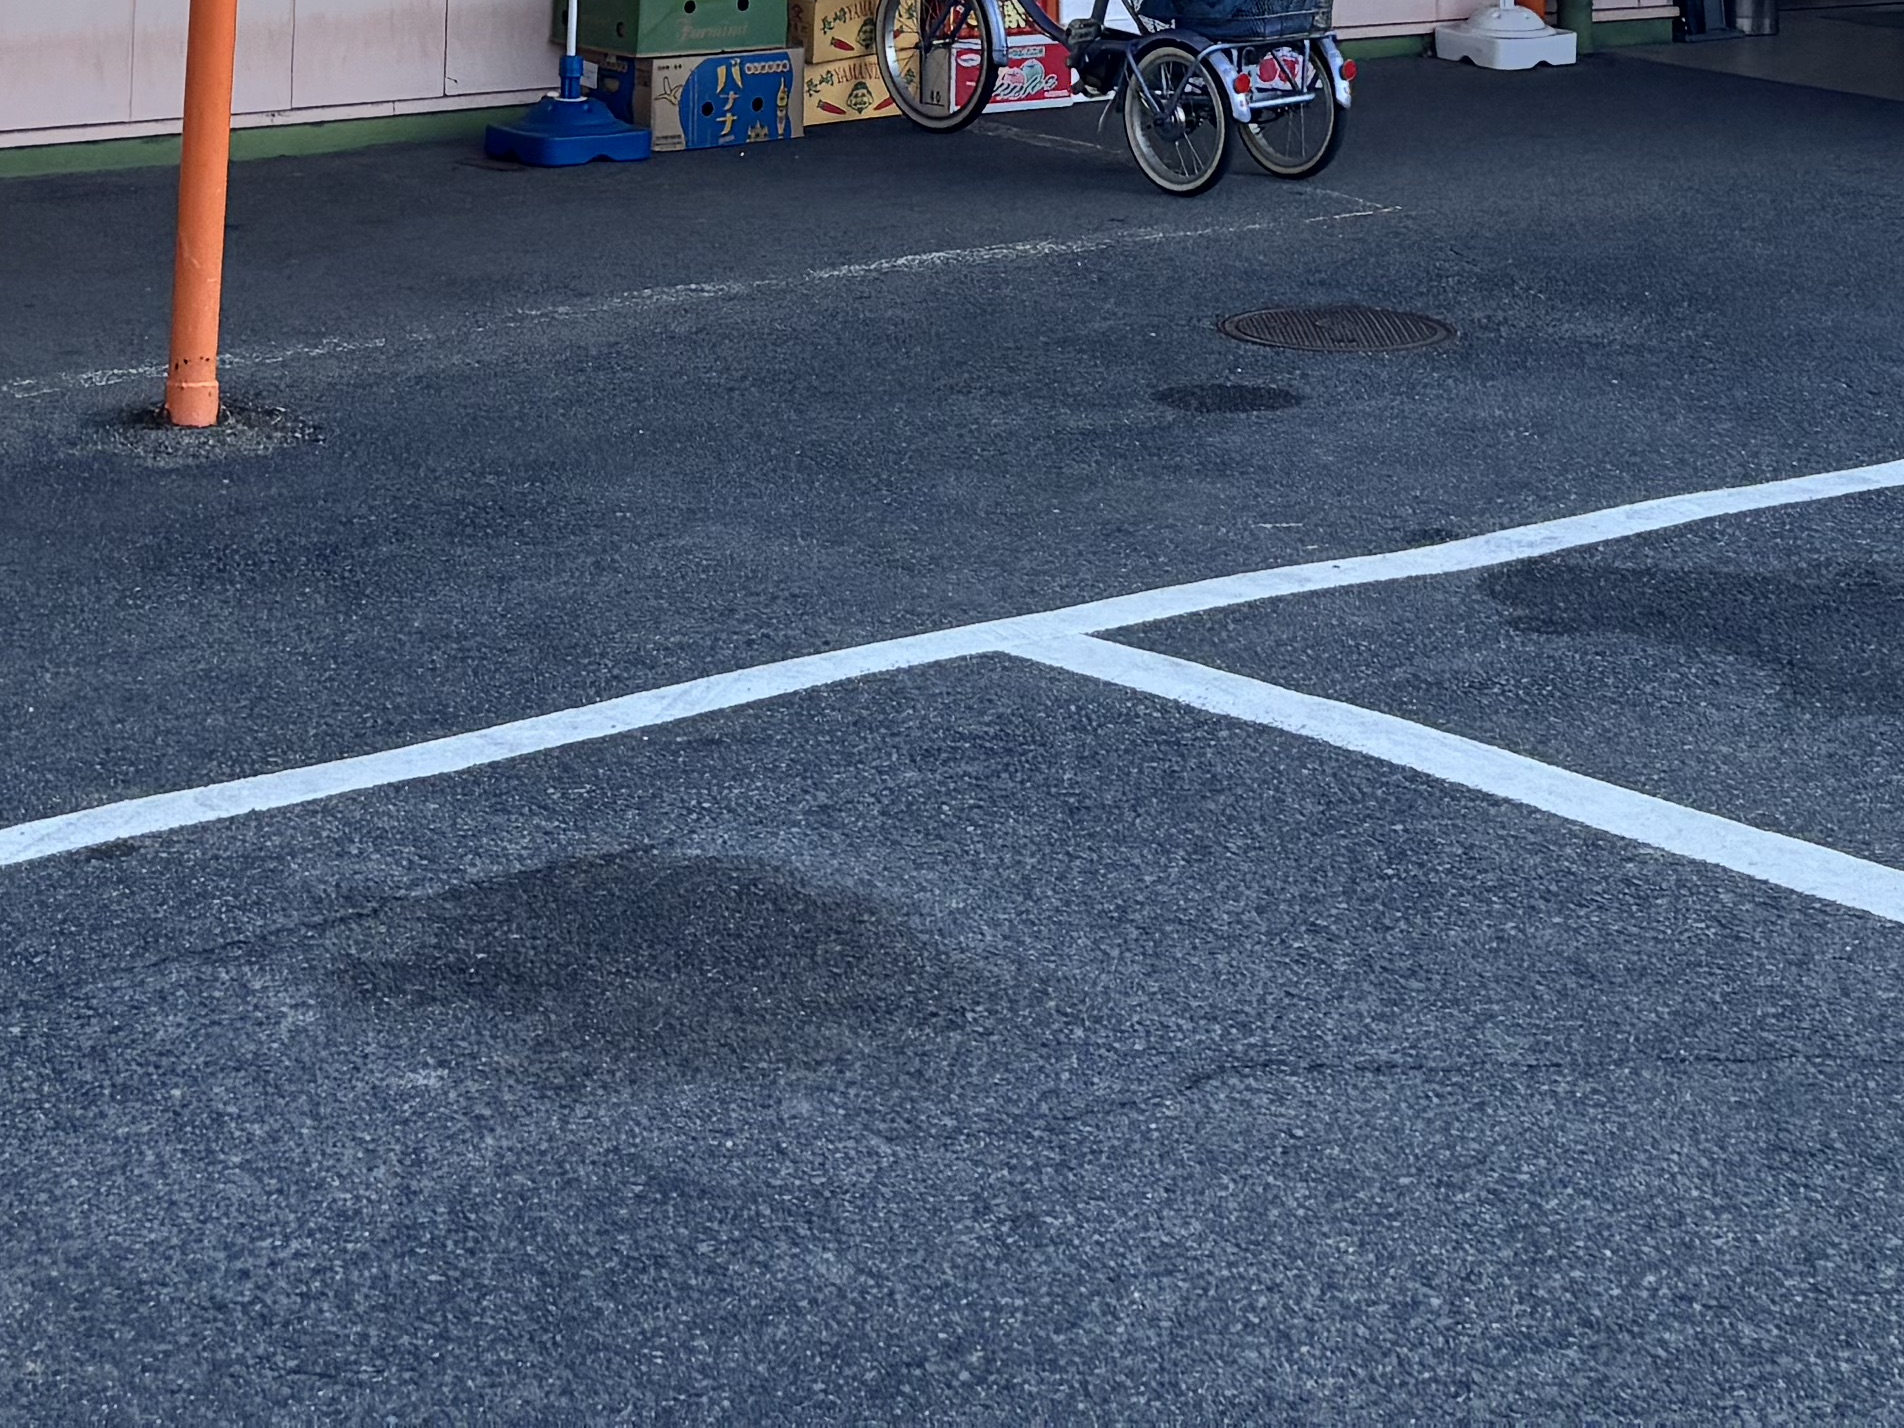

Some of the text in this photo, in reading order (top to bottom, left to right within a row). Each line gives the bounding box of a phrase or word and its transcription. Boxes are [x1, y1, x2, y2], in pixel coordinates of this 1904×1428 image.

[822, 6, 847, 35] 長崎
[716, 58, 743, 136] バナナ
[806, 69, 834, 97] 長崎
